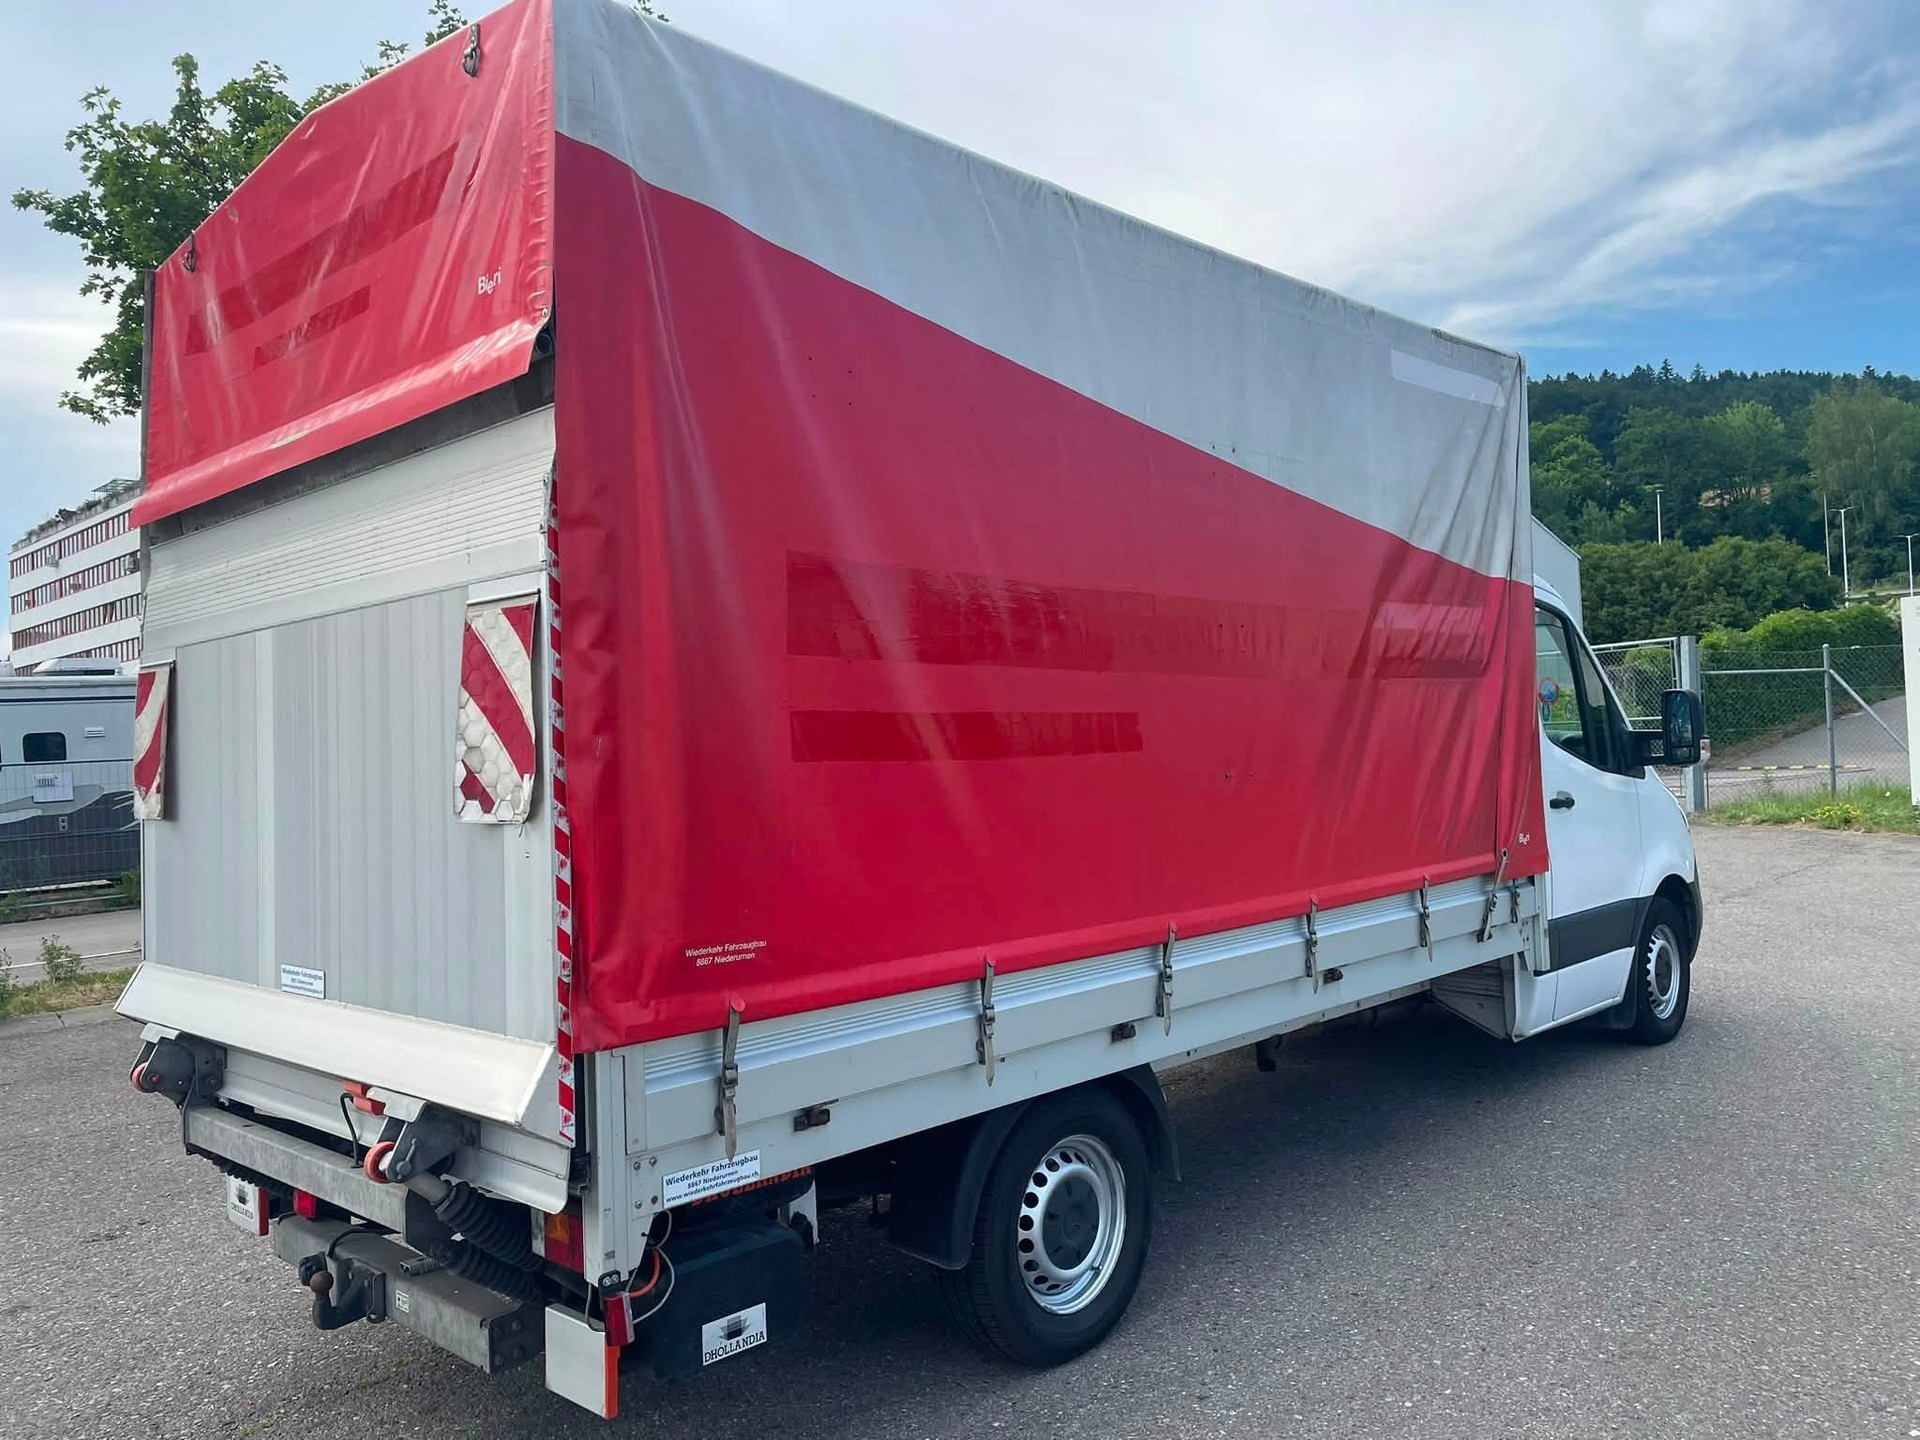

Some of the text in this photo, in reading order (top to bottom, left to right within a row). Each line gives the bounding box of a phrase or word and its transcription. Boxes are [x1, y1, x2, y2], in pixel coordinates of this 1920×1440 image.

[478, 266, 501, 295] Bieri
[685, 940, 767, 958] Wiederkehr Fahrzeugbau
[696, 956, 713, 967] 8867
[665, 1168, 710, 1186] Wiederkehr
[711, 1154, 759, 1174] Fahrzeugbau
[687, 1170, 739, 1189] 8867 Niederurnen
[704, 1331, 765, 1362] DHOLLANDIA
